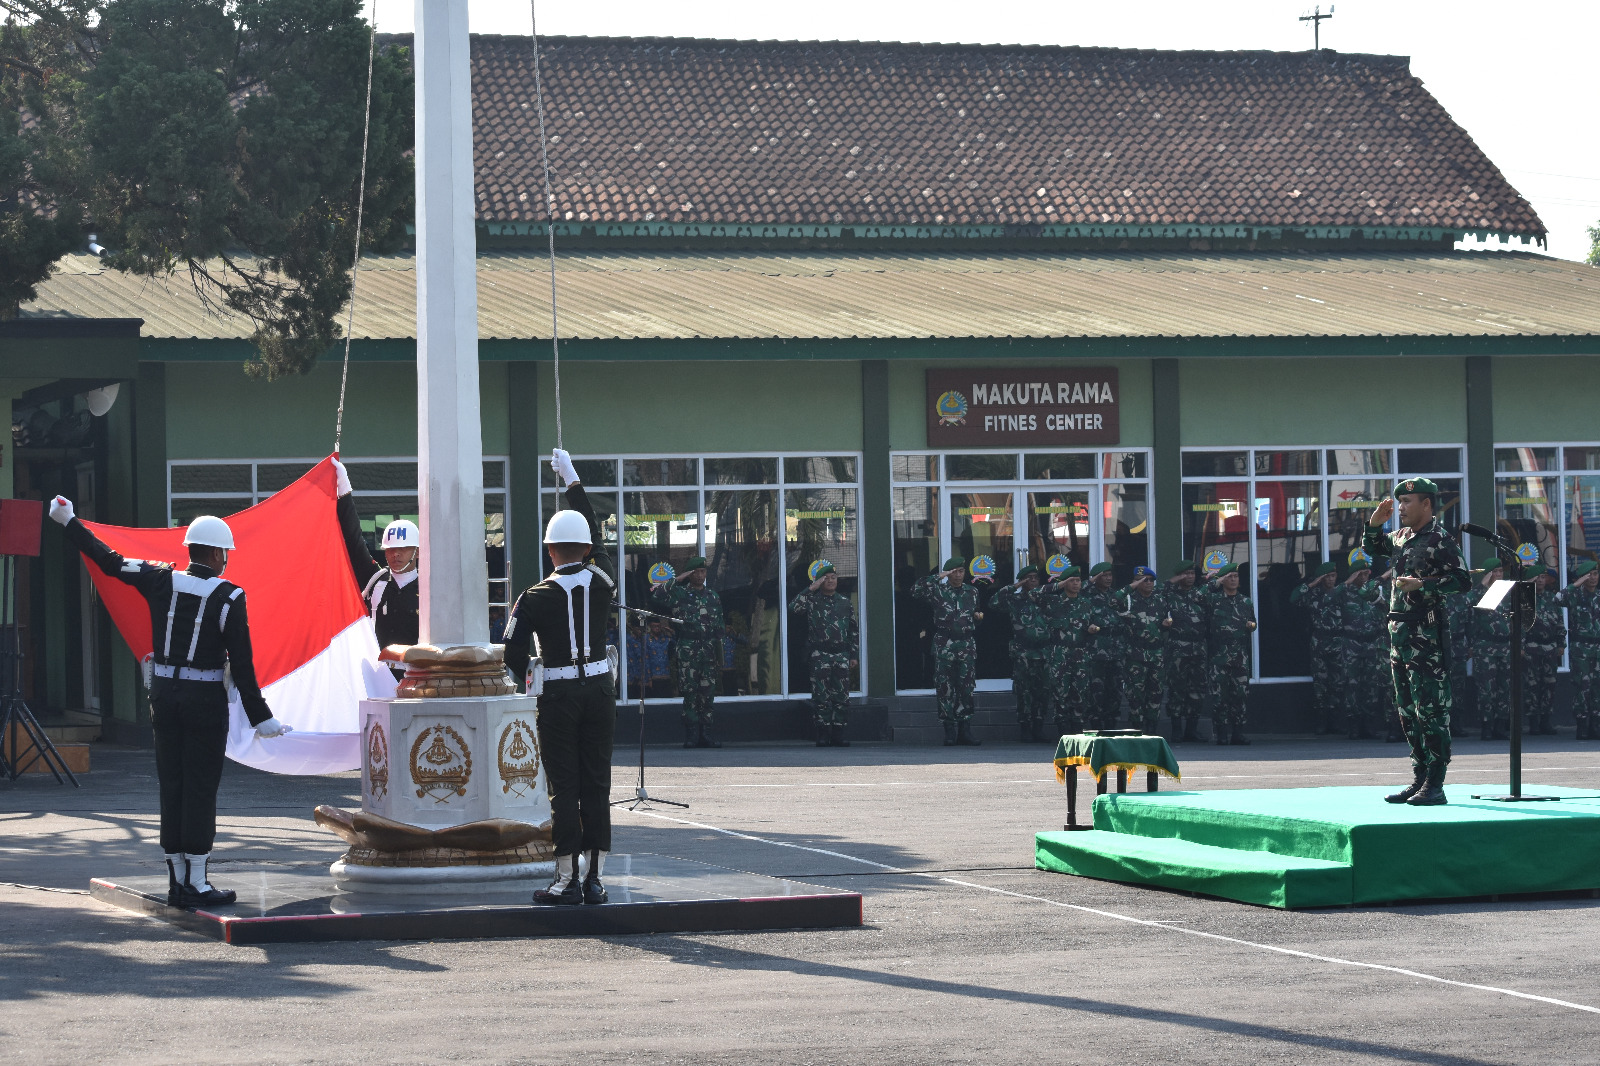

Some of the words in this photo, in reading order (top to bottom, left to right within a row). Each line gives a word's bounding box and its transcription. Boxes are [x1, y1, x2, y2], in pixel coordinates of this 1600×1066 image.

[972, 383, 1054, 405] MAKUTA
[1058, 382, 1113, 404] RAMA
[985, 414, 1037, 431] FITNES
[1046, 413, 1103, 431] CENTER
[388, 526, 407, 541] PM
